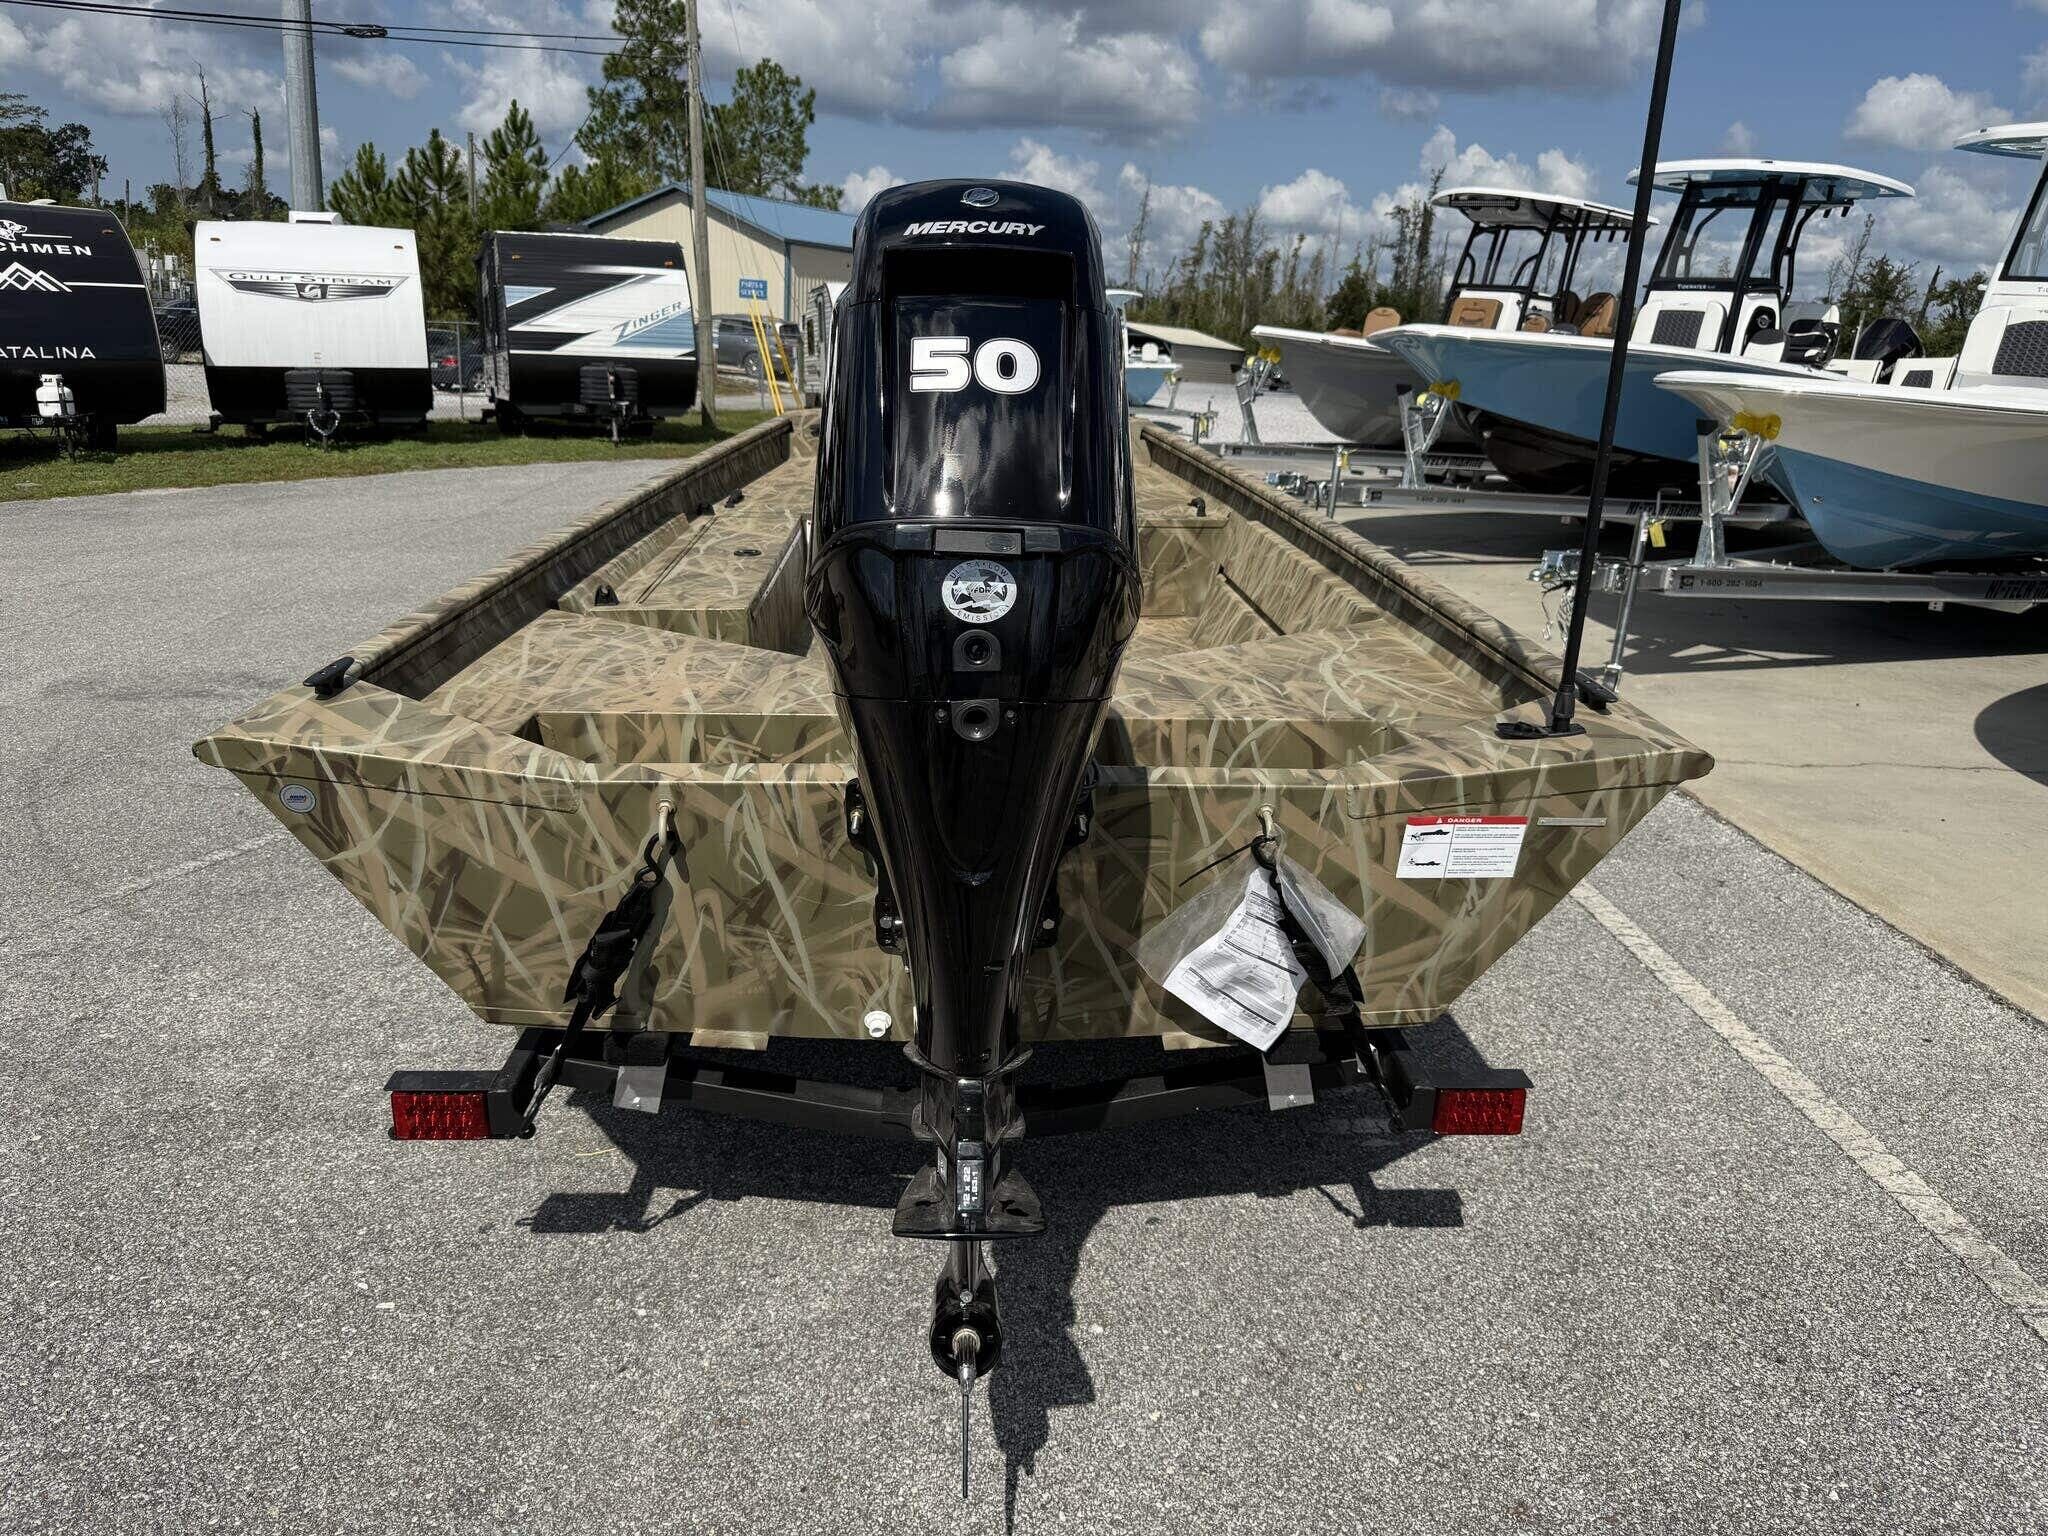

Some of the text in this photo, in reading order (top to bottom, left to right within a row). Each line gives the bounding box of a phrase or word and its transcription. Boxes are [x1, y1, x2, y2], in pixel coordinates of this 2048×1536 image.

[903, 220, 1046, 236] MERCURY
[611, 301, 682, 342] ZINGER
[910, 336, 1041, 394] 50
